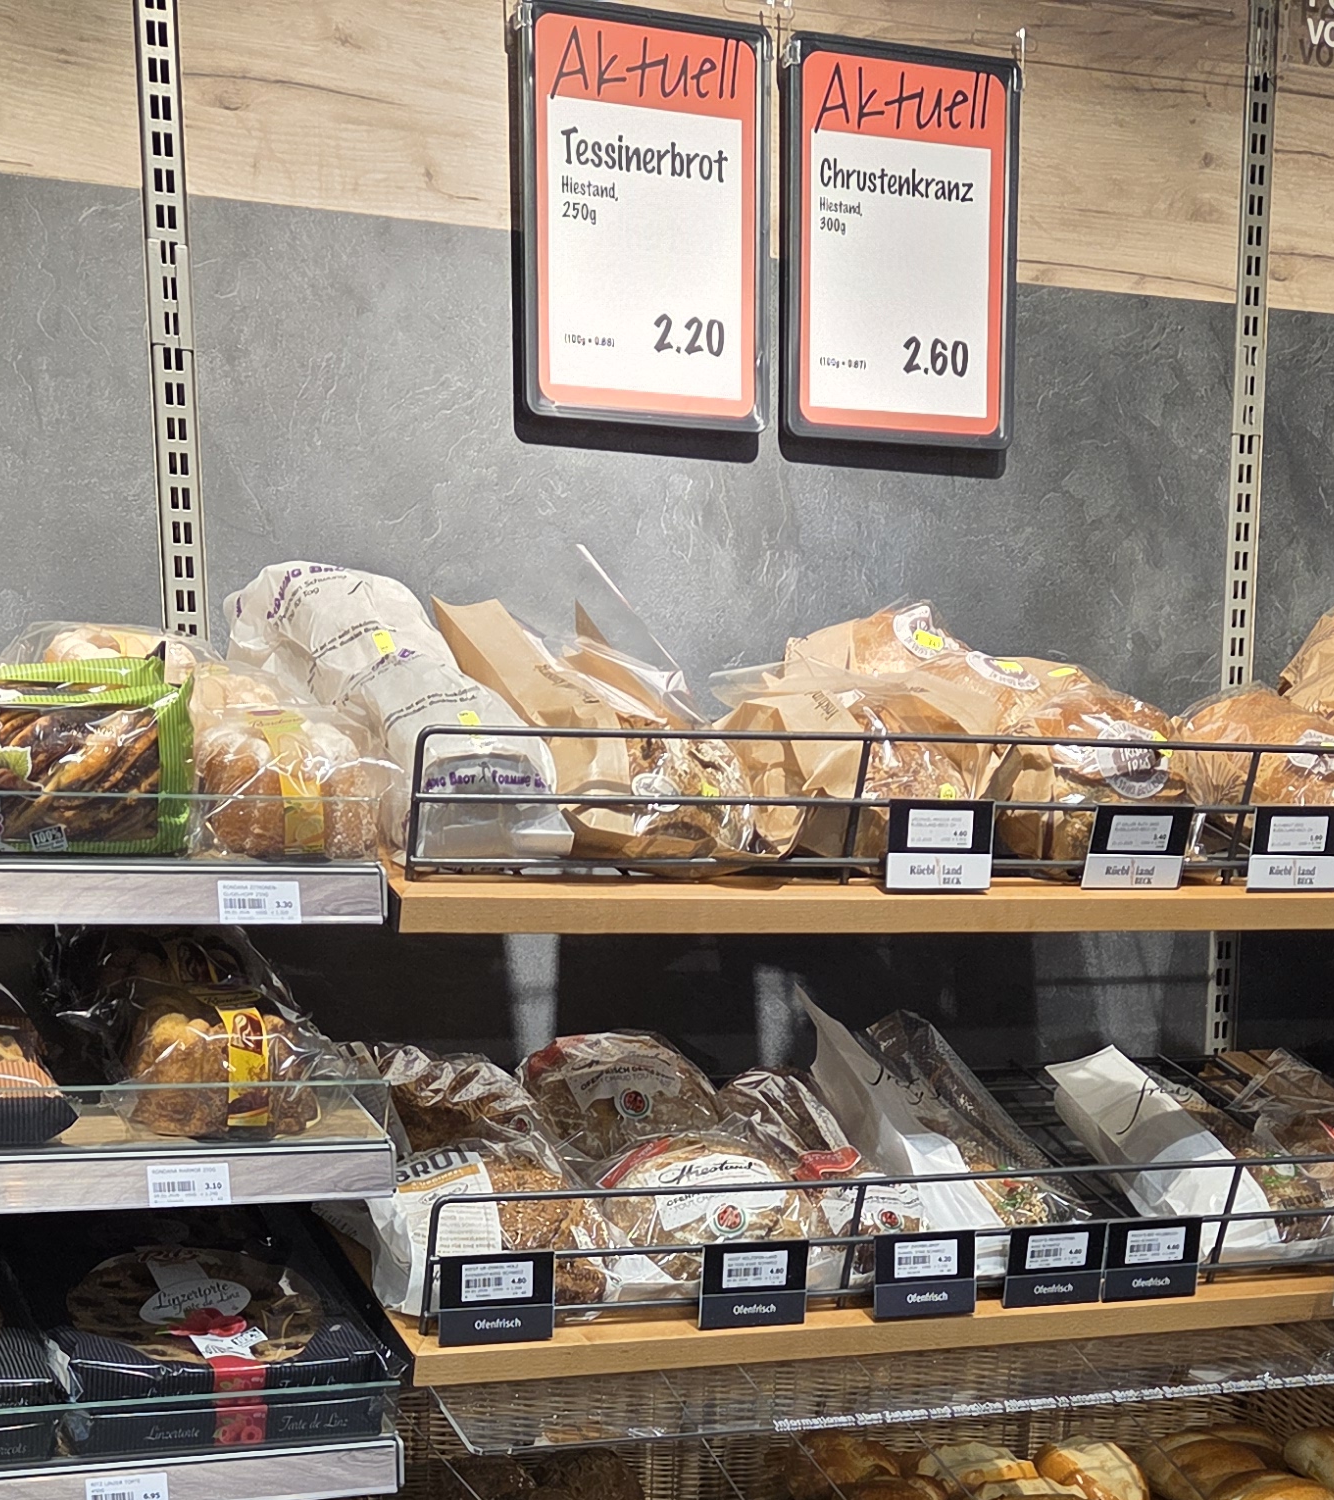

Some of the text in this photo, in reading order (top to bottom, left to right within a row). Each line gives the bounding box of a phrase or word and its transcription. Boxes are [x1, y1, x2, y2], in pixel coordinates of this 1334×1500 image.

[550, 26, 739, 99] Aktuell
[814, 62, 991, 134] Aktuell
[561, 127, 728, 183] Tessinerbrot
[561, 177, 619, 202] Hiestand,
[819, 157, 975, 204] Chrustenkranz
[562, 201, 597, 225] 250g
[818, 197, 864, 218] Hiestand,
[819, 215, 846, 236] 300g
[653, 314, 725, 357] 2.20
[903, 336, 969, 378] 2.60
[33, 828, 62, 844] 100%
[658, 1160, 756, 1186] Hiestand
[1033, 1282, 1073, 1297] Ofenfrisch
[1132, 1275, 1170, 1289] Ofenfrisch
[733, 1302, 776, 1317] Ofenfrisch
[906, 1290, 949, 1306] Ofenfrisch
[474, 1316, 522, 1333] Ofenfrisch
[774, 1413, 854, 1431] Informationen
[855, 1410, 884, 1425] über
[885, 1407, 929, 1423] Zutaten
[929, 1404, 952, 1418] und
[953, 1400, 1001, 1417] mögliche
[1003, 1395, 1055, 1411] Allergene
